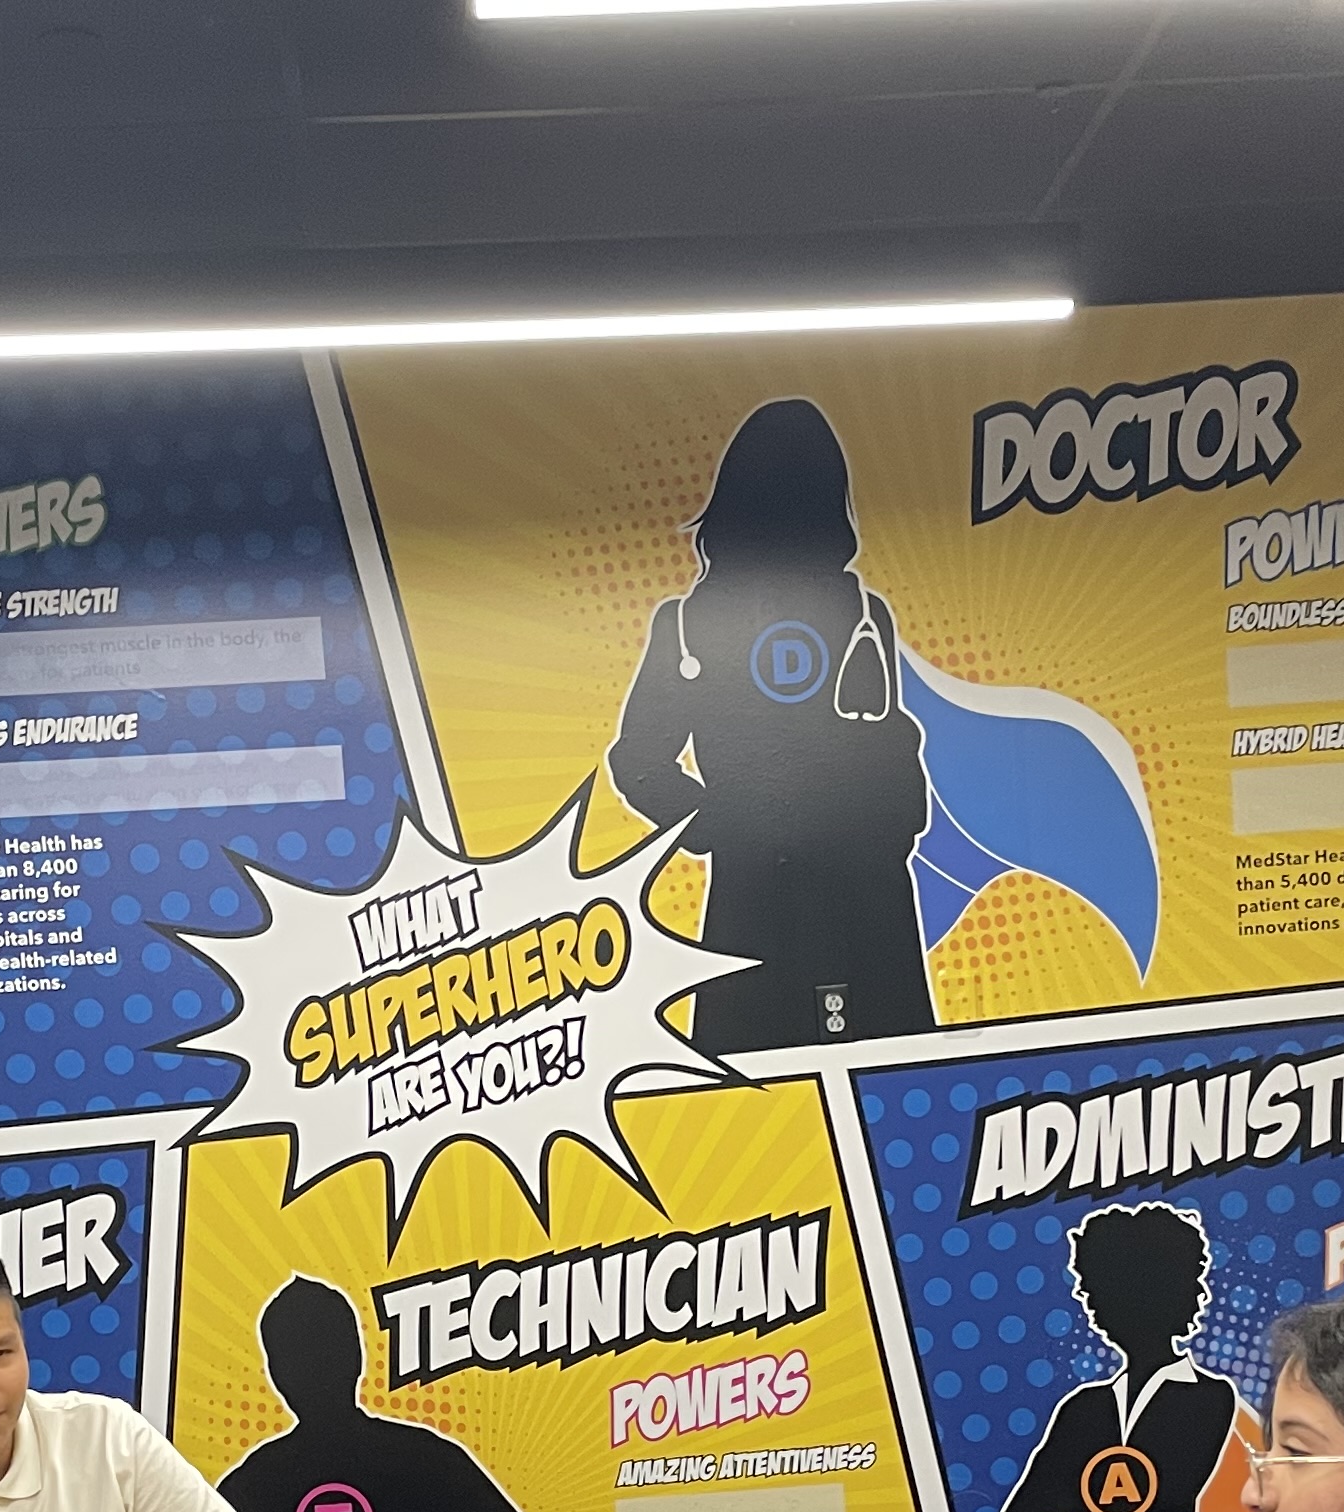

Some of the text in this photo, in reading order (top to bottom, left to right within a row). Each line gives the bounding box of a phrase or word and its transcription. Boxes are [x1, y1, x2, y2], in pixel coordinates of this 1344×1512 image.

[975, 363, 1299, 521] DOCTOR
[7, 587, 119, 620] STRENGTH
[772, 640, 813, 685] D
[13, 713, 138, 746] ENDURANCE
[1231, 725, 1308, 758] HYBRID
[4, 834, 67, 855] Health
[70, 835, 103, 852] has
[1235, 852, 1310, 870] MedStar
[22, 858, 78, 881] 8,400
[1236, 874, 1275, 892] than
[1280, 871, 1332, 891] 5,400
[52, 882, 81, 899] for
[1237, 896, 1300, 917] patient
[7, 908, 67, 925] across
[349, 868, 483, 972] WHAT
[1238, 917, 1341, 936] innovations
[47, 926, 83, 944] and
[285, 898, 631, 1087] SUPERHERO
[368, 1016, 586, 1137] ARE YOU?!
[375, 1211, 828, 1388] TECHNICIAN
[610, 1349, 810, 1448] POWERS
[614, 1442, 877, 1488] AMAZING ATTENTIVENESS
[1099, 1463, 1142, 1504] A
